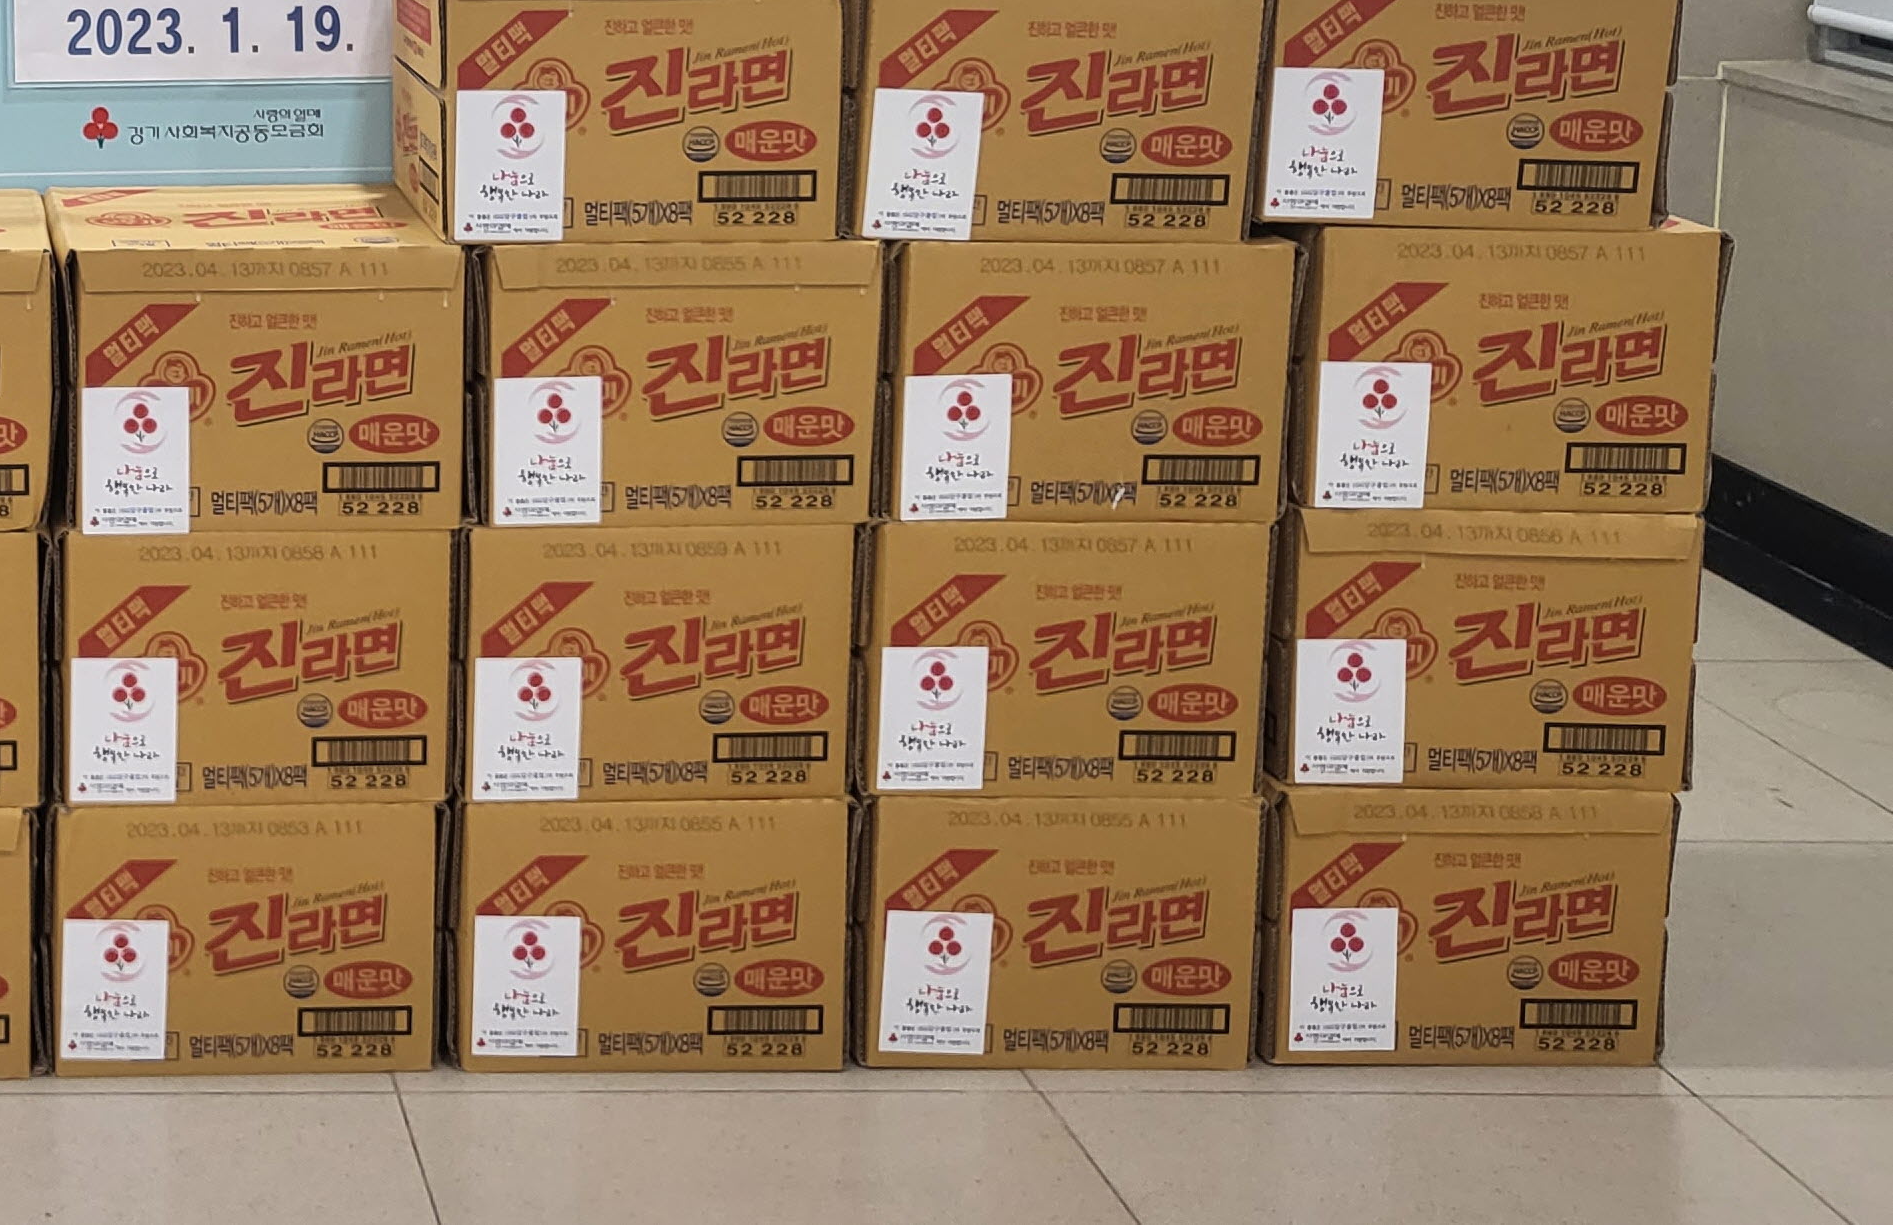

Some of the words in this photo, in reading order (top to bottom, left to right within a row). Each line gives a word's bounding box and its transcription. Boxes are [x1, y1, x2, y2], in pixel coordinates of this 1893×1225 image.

[67, 7, 196, 56] 2023.
[286, 4, 354, 53] 19.
[601, 48, 792, 136] 진라면
[1020, 52, 1214, 136] 진라면
[1426, 35, 1625, 120] 진라면
[733, 126, 809, 155] 매운맛
[1148, 130, 1226, 160] 매운맛
[1557, 115, 1636, 146] 매운맛
[226, 342, 415, 427] 진라면
[642, 336, 830, 422] 진라면
[1052, 335, 1244, 419] 진라면
[1472, 323, 1668, 406] 진라면
[357, 419, 432, 447] 매운맛
[772, 411, 847, 441] 매운맛
[1179, 412, 1256, 441] 매운맛
[1603, 400, 1681, 429] 매운맛
[218, 621, 403, 705] 진라면
[620, 617, 806, 701] 진라면
[1028, 613, 1217, 695] 진라면
[1448, 603, 1645, 685] 진라면
[346, 694, 420, 723] 매운맛
[747, 690, 822, 719] 매운맛
[1155, 688, 1231, 717] 매운맛
[1581, 680, 1659, 710] 매운맛
[205, 894, 388, 976] 진라면
[614, 891, 800, 973] 진라면
[1022, 887, 1210, 968] 진라면
[1428, 881, 1617, 963] 진라면
[332, 965, 405, 993] 매운맛
[742, 964, 816, 992] 매운맛
[1149, 962, 1225, 990] 매운맛
[1556, 956, 1632, 985] 매운맛
